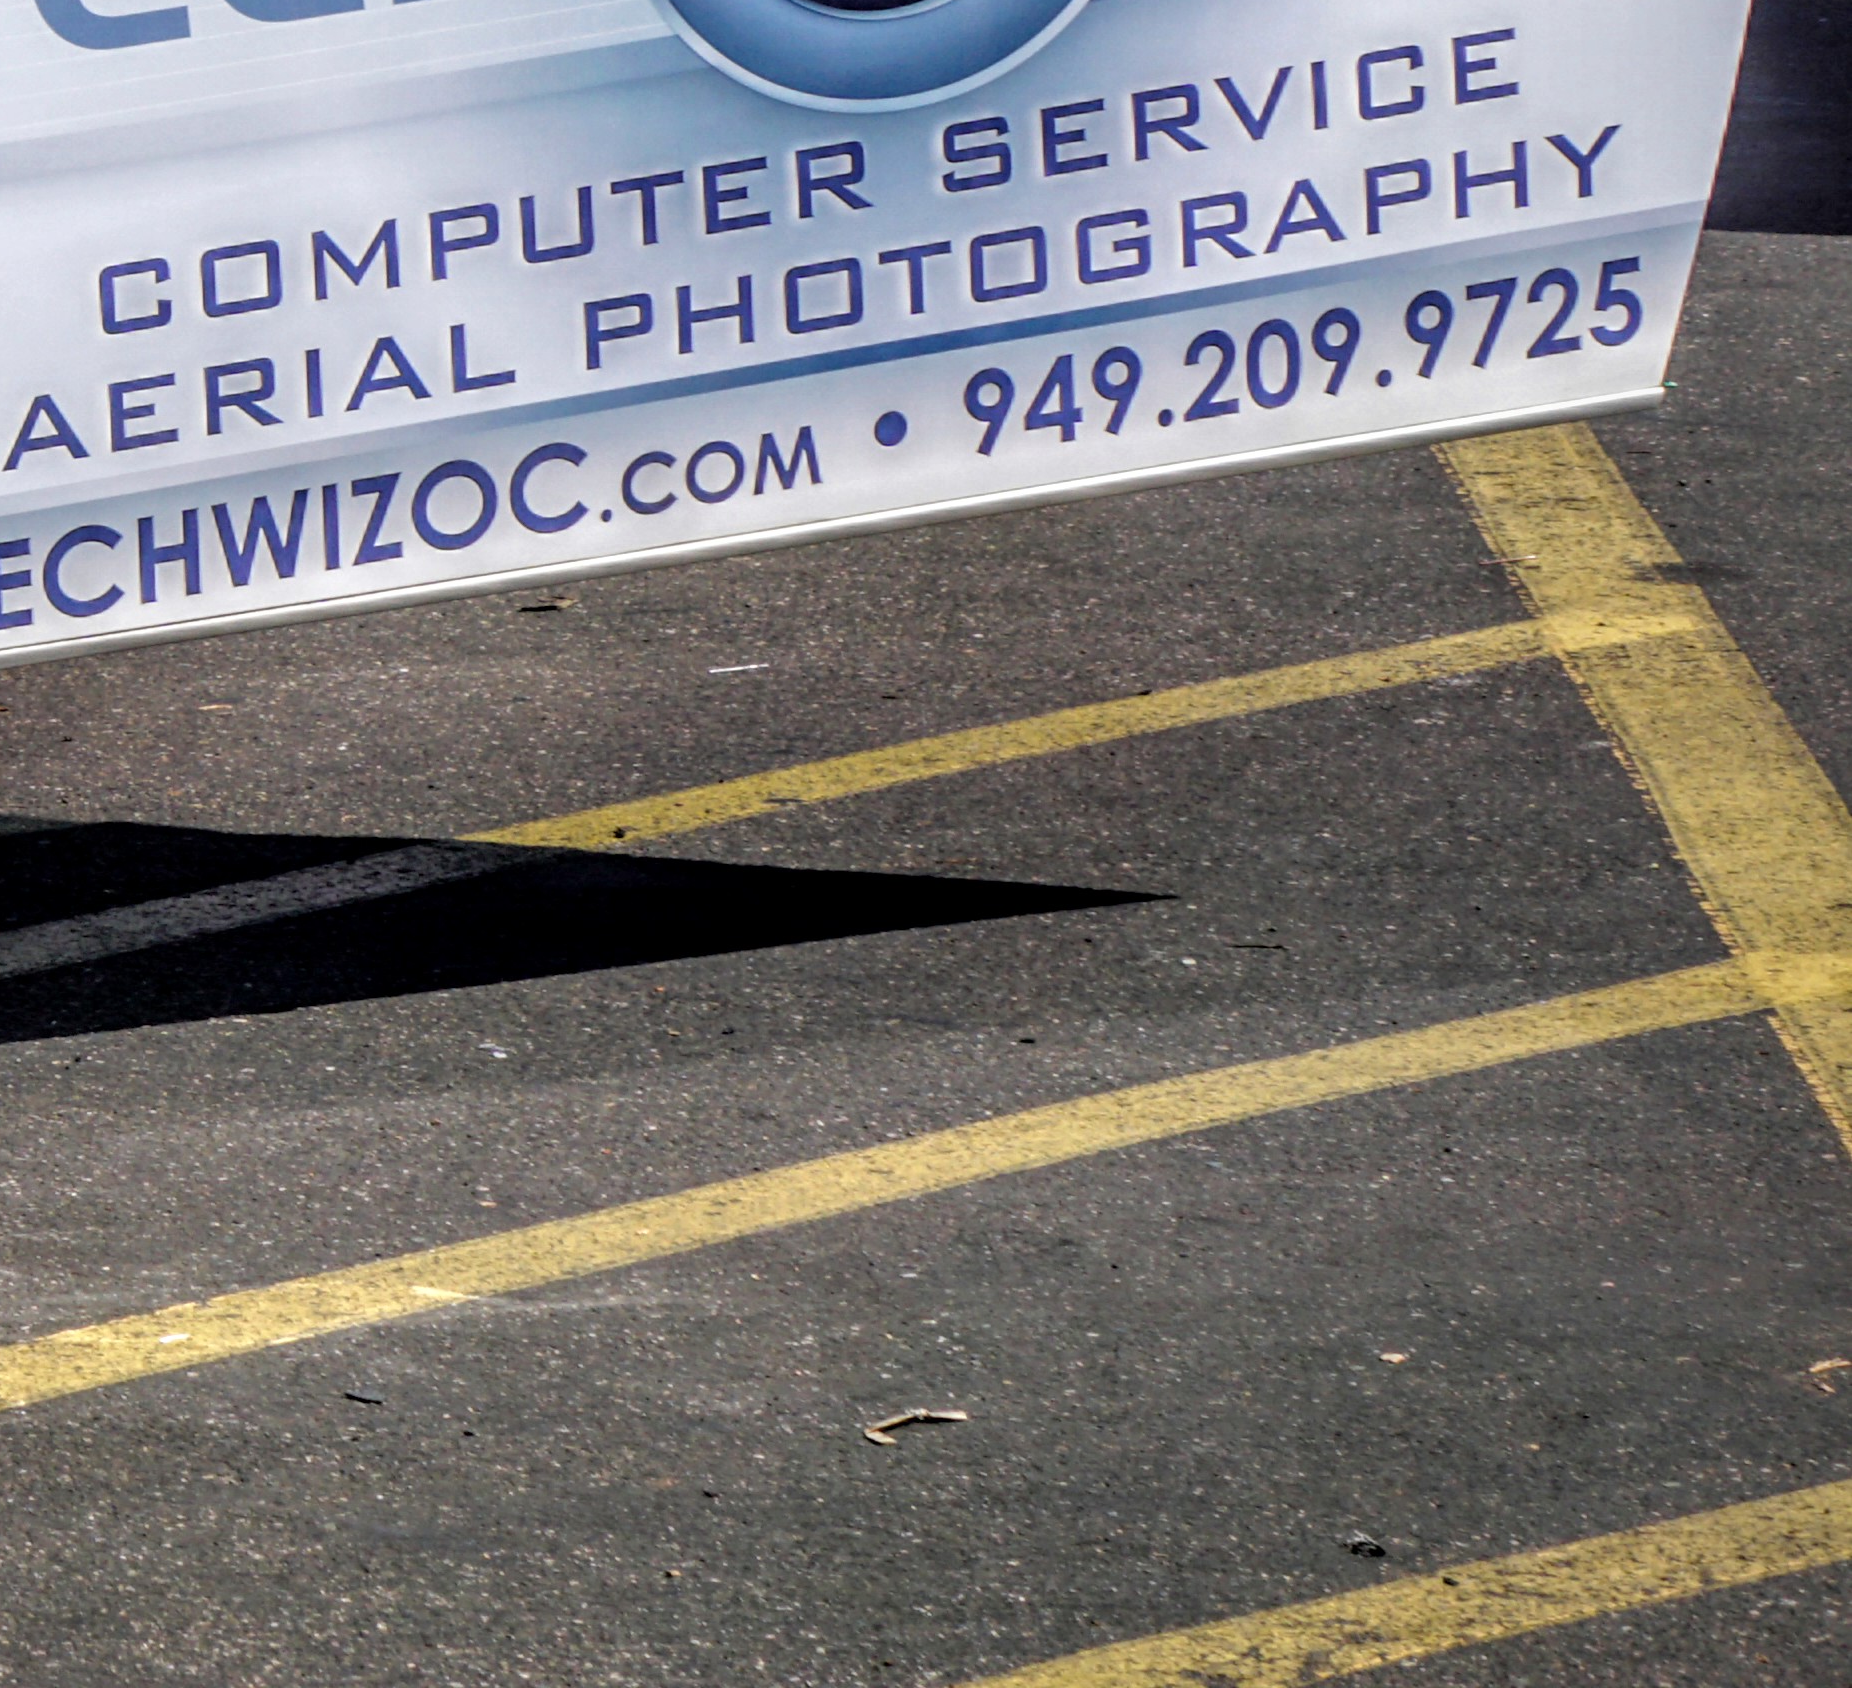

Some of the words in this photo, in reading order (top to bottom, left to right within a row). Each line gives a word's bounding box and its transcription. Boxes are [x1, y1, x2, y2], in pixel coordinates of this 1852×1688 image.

[2, 323, 517, 471] AERIAL
[583, 124, 1622, 370] PHOTOGRAPHY
[98, 140, 874, 335] COMPUTER
[941, 27, 1519, 193] SERVICE
[963, 256, 1643, 457] 949.209.9725
